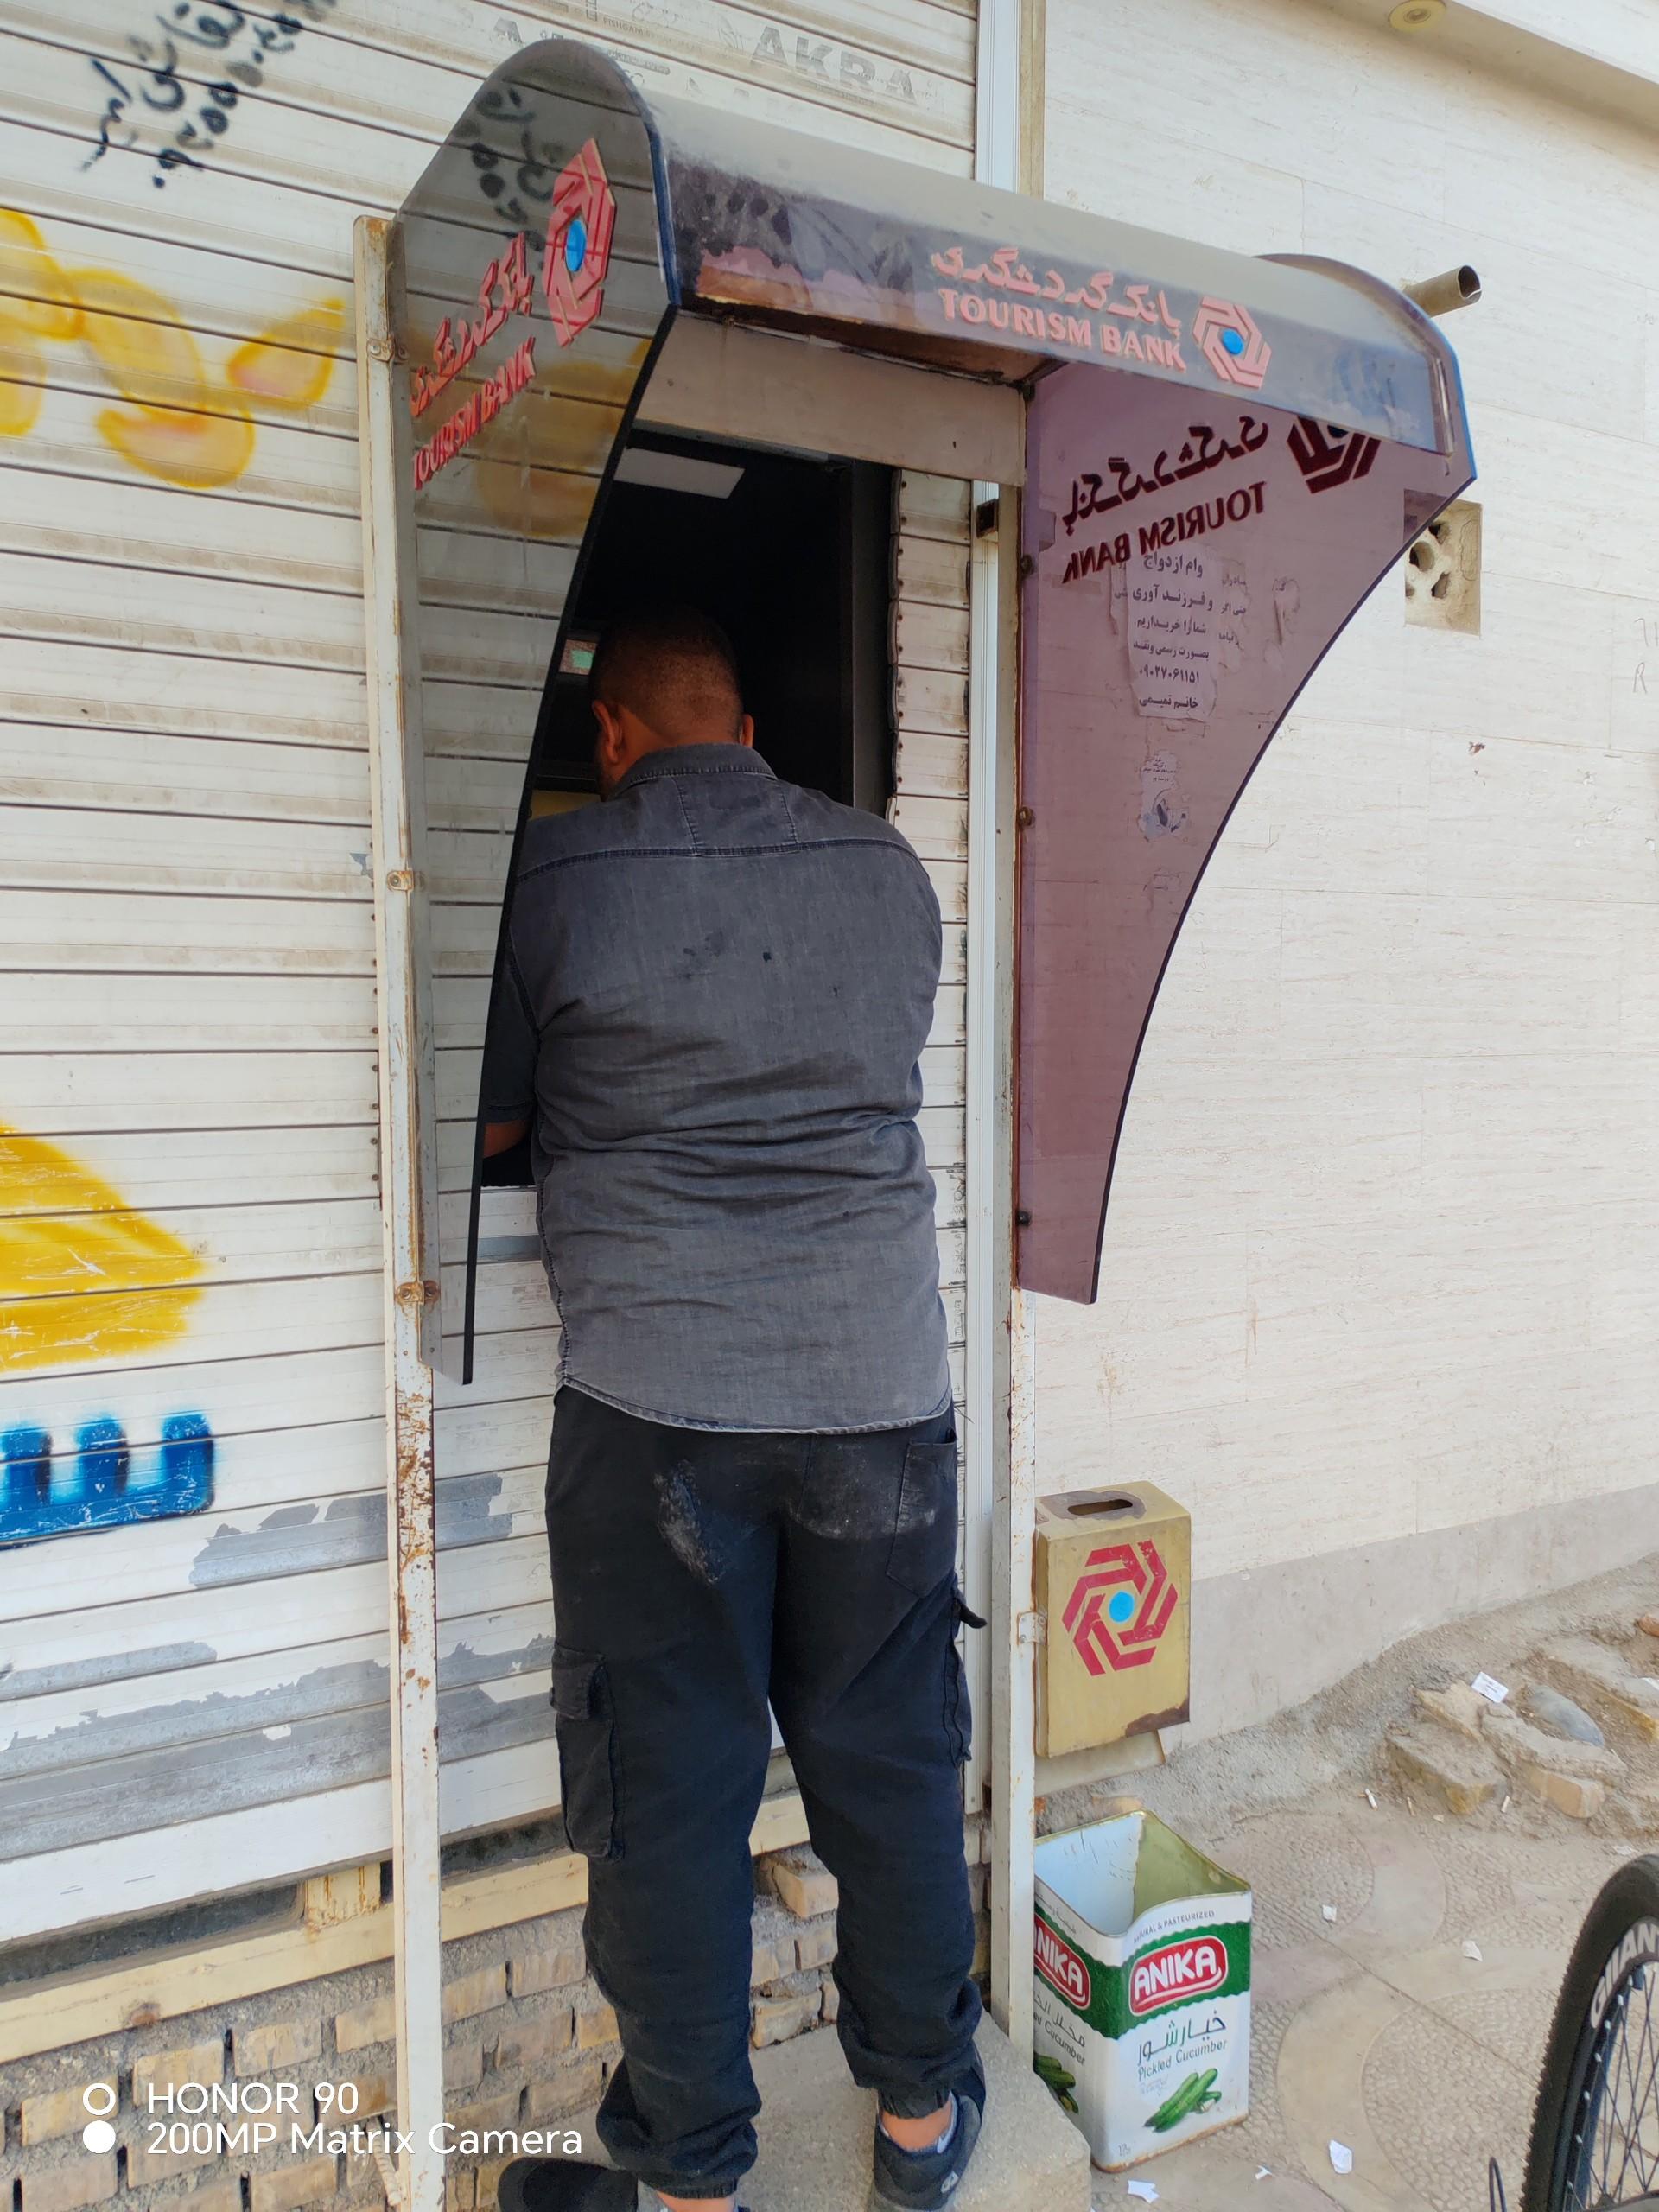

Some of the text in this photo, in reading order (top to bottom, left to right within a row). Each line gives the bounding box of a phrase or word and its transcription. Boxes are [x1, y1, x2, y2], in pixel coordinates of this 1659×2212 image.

[931, 246, 1181, 338] بانک گردشگری
[938, 288, 1186, 373] TOURISM BANK
[413, 336, 536, 490] TOURISM BANK
[1185, 557, 1203, 578] وام
[1164, 1910, 1215, 1928] PASTEURIZED
[1034, 1926, 1084, 1996] NIKA
[1135, 1945, 1217, 2001] ANIKA
[1045, 2020, 1085, 2065] Cucumber
[1138, 2039, 1227, 2082] Pickled Cucumber
